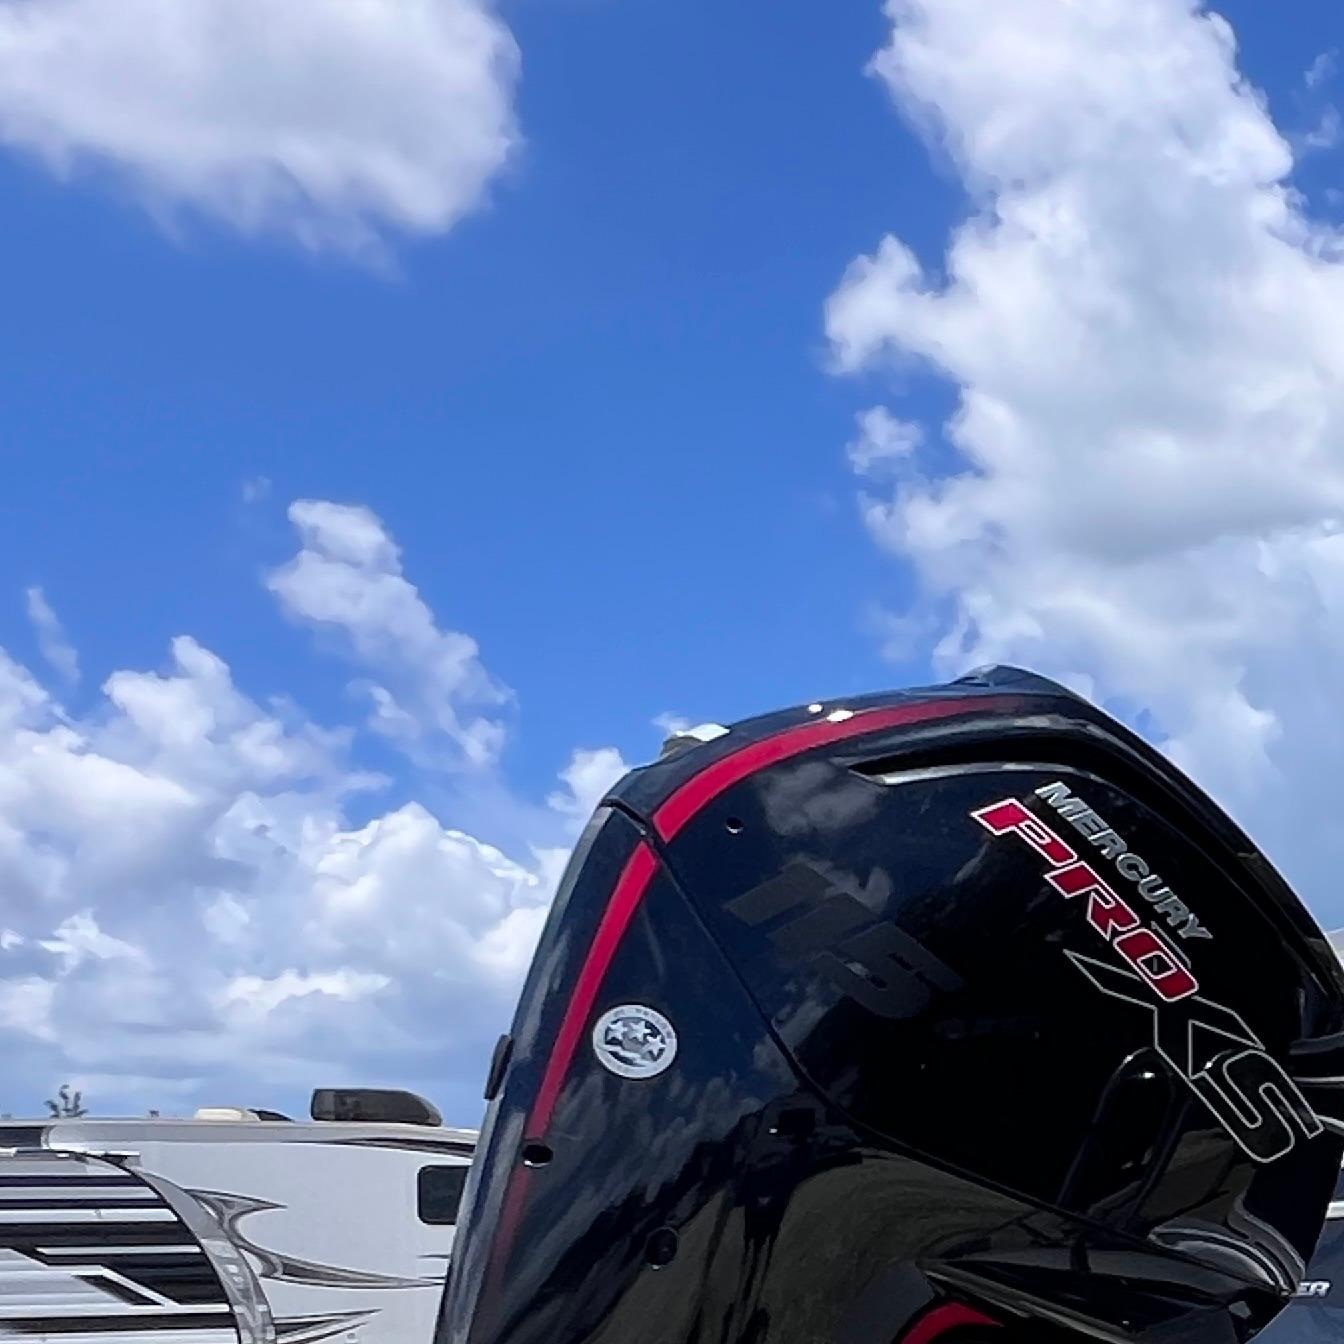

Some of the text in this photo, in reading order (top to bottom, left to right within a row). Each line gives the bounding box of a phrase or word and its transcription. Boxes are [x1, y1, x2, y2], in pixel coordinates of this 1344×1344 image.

[725, 862, 967, 1018] 115
[1034, 781, 1213, 942] MERCURY
[970, 798, 1324, 1164] PRO XS
